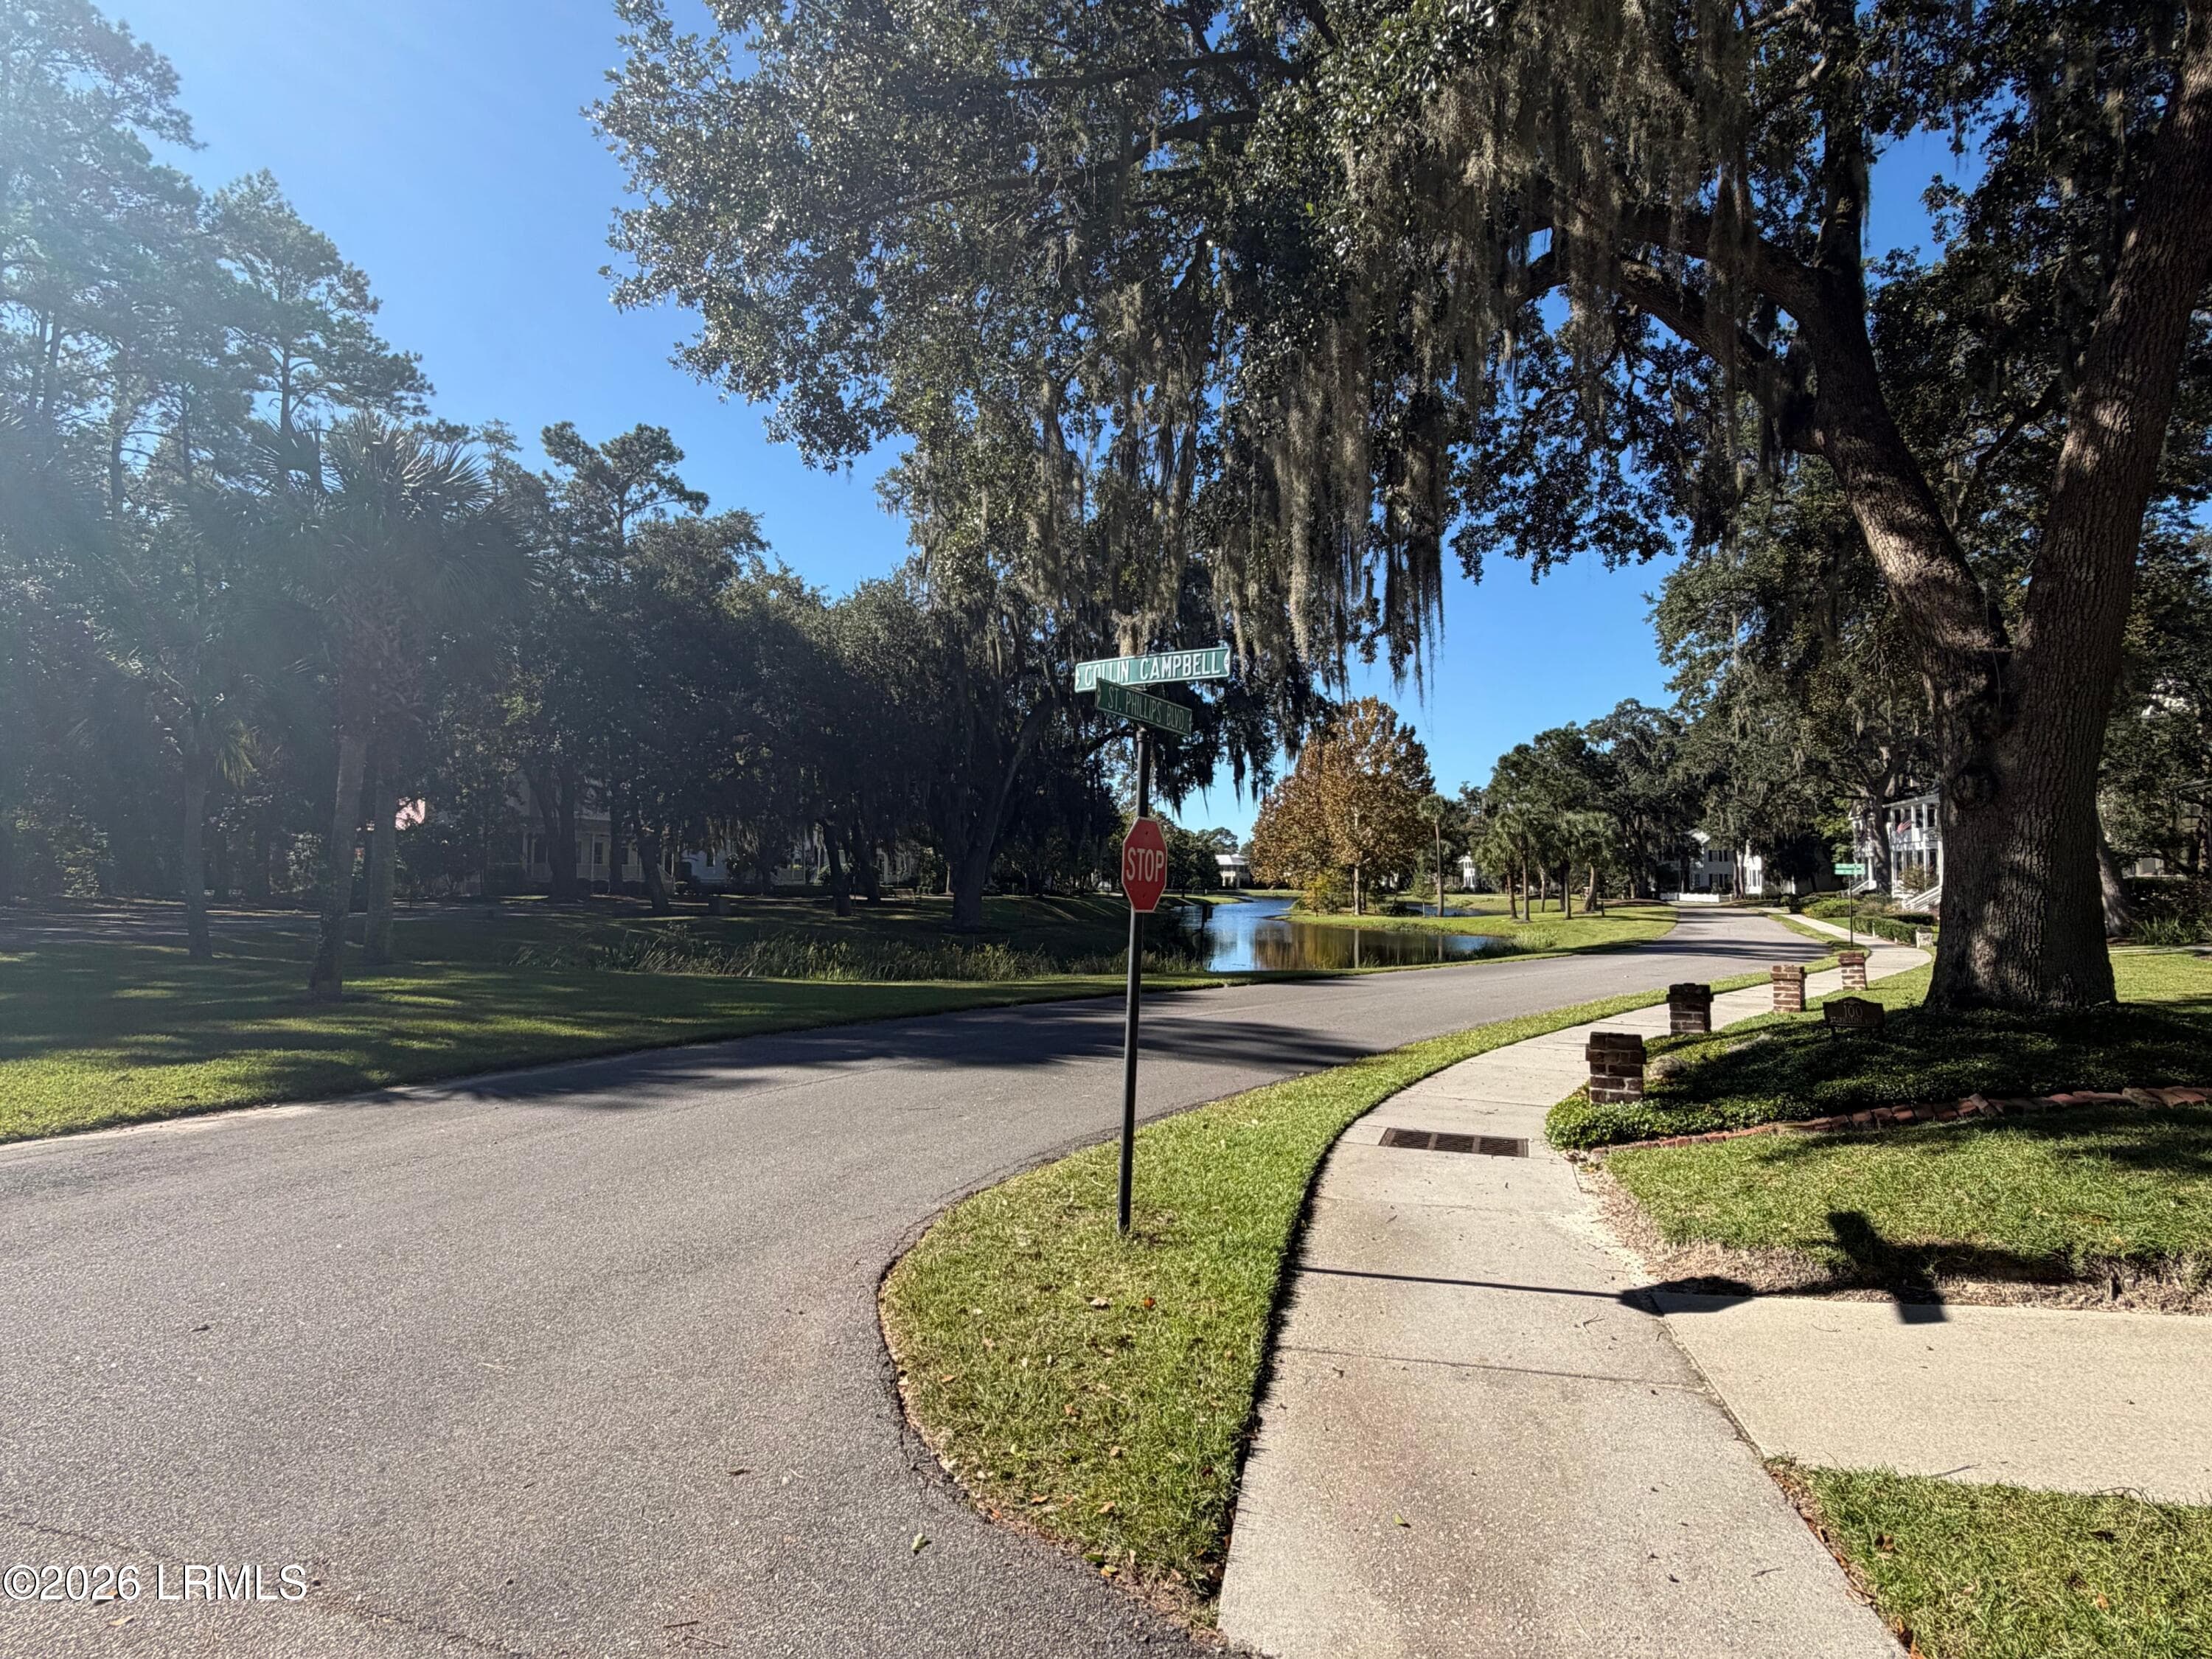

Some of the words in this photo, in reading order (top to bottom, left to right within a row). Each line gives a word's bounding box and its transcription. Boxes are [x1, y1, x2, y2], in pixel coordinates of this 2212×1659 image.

[1140, 651, 1220, 680] CAMPBELL
[1108, 686, 1121, 711] ST.
[1125, 691, 1161, 723] PHILLIPS
[1166, 705, 1186, 731] BLVD.
[1126, 846, 1165, 883] STOP
[1843, 1004, 1863, 1018] 100
